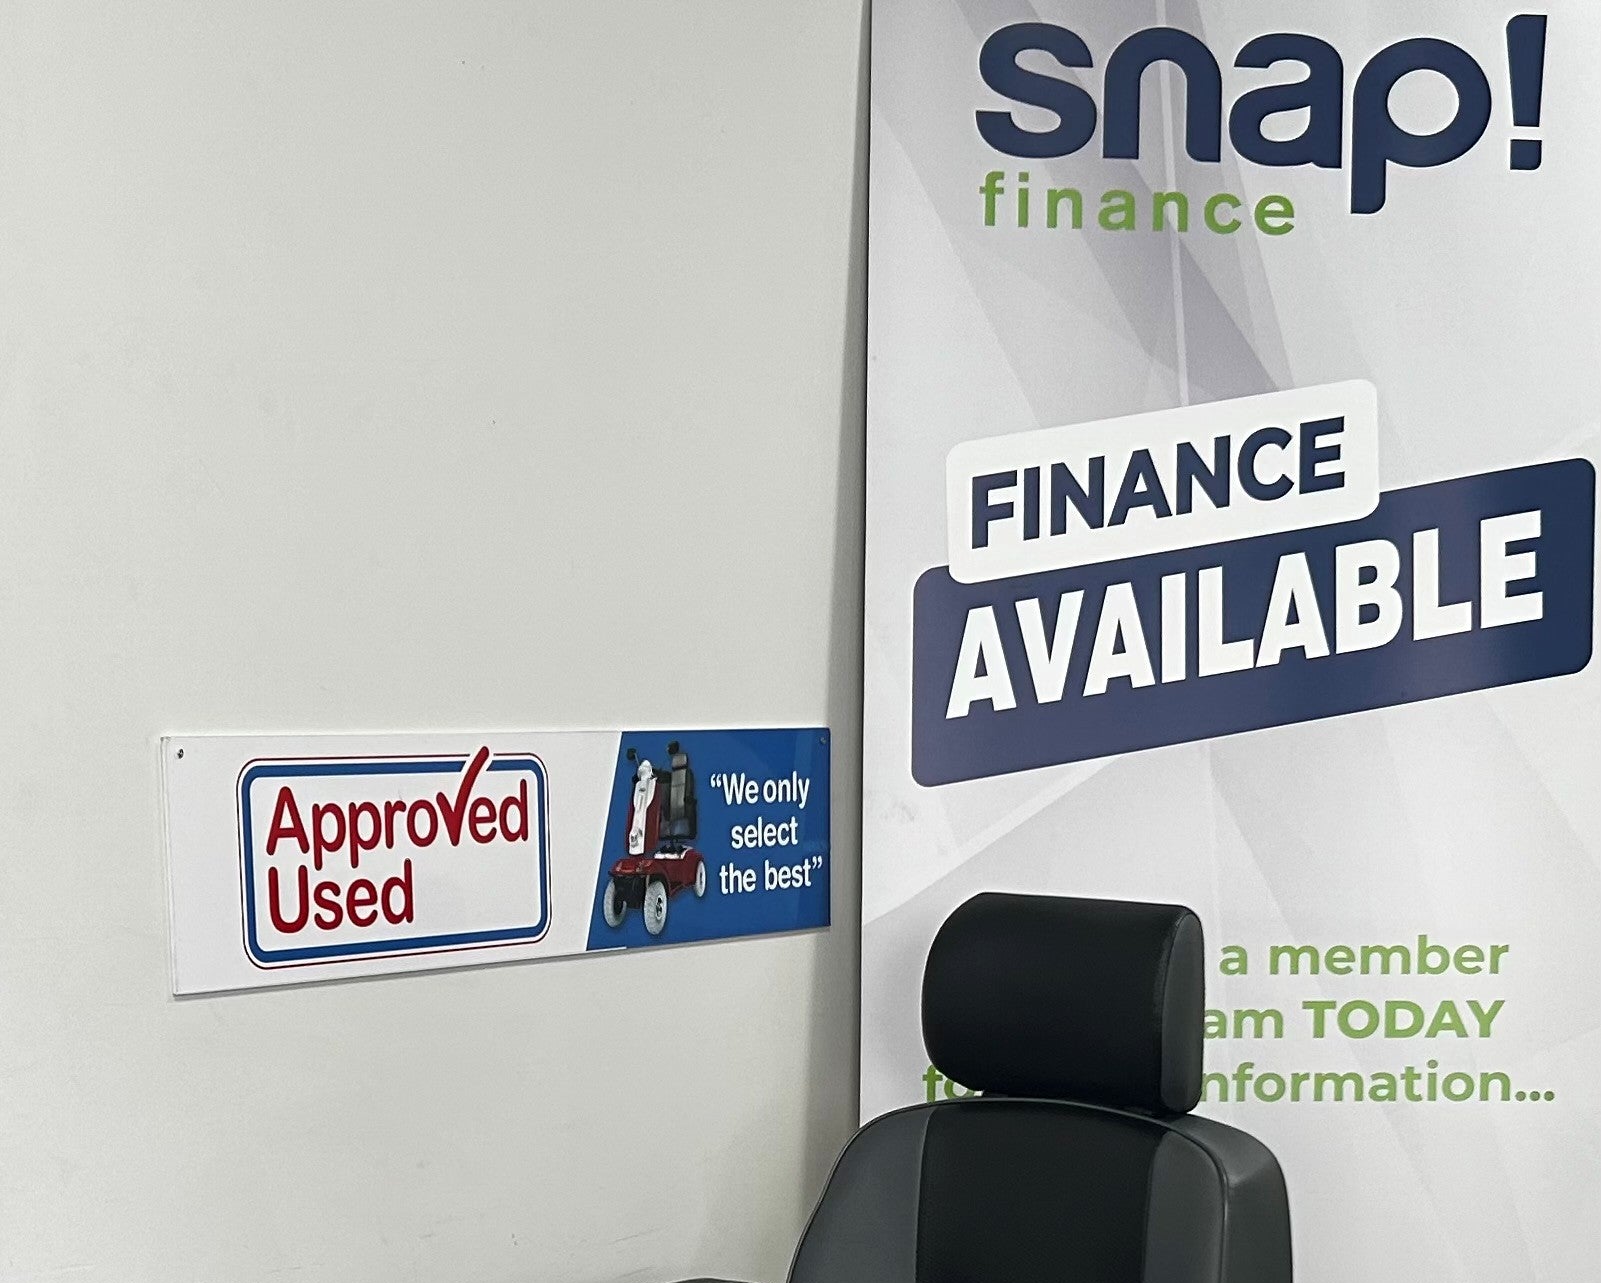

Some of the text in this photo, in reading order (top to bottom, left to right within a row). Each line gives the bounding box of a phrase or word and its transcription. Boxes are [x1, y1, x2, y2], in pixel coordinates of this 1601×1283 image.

[975, 13, 1548, 215] snap!
[979, 171, 1295, 236] finance
[971, 416, 1345, 550] FINANCE
[945, 510, 1544, 719] AVAILABLE
[266, 746, 528, 869] Approved
[710, 770, 810, 809] “We only
[731, 816, 799, 849] select
[268, 857, 414, 934] Used
[719, 855, 823, 895] the best”
[1219, 935, 1509, 975] a member
[1203, 1000, 1505, 1039] am TODAY
[1199, 1061, 1555, 1102] nformation...
